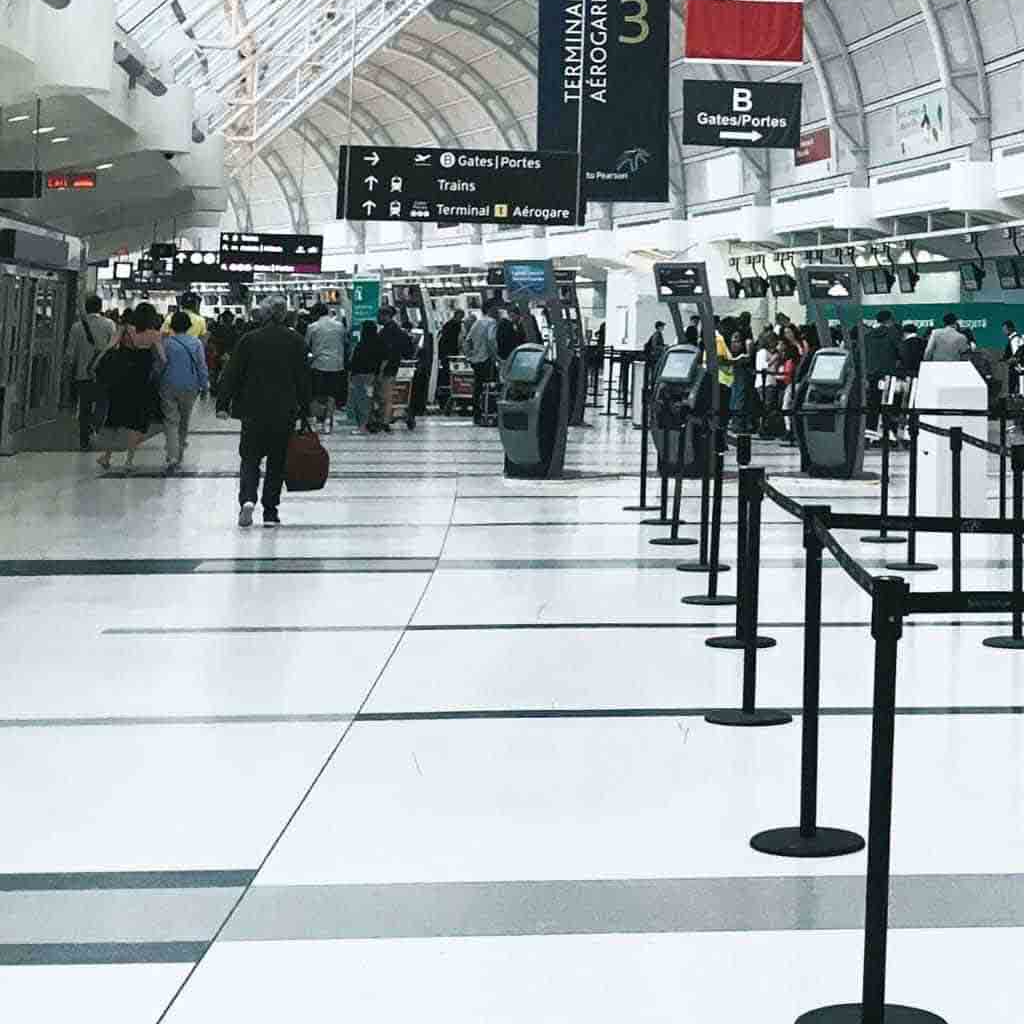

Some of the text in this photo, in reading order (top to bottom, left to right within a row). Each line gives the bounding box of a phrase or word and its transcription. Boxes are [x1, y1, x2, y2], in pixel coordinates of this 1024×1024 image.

[732, 87, 752, 112] B
[696, 112, 787, 128] Gates/Portes
[437, 179, 476, 192] Trains
[436, 204, 490, 217] Terminal
[512, 205, 570, 220] Aérogare
